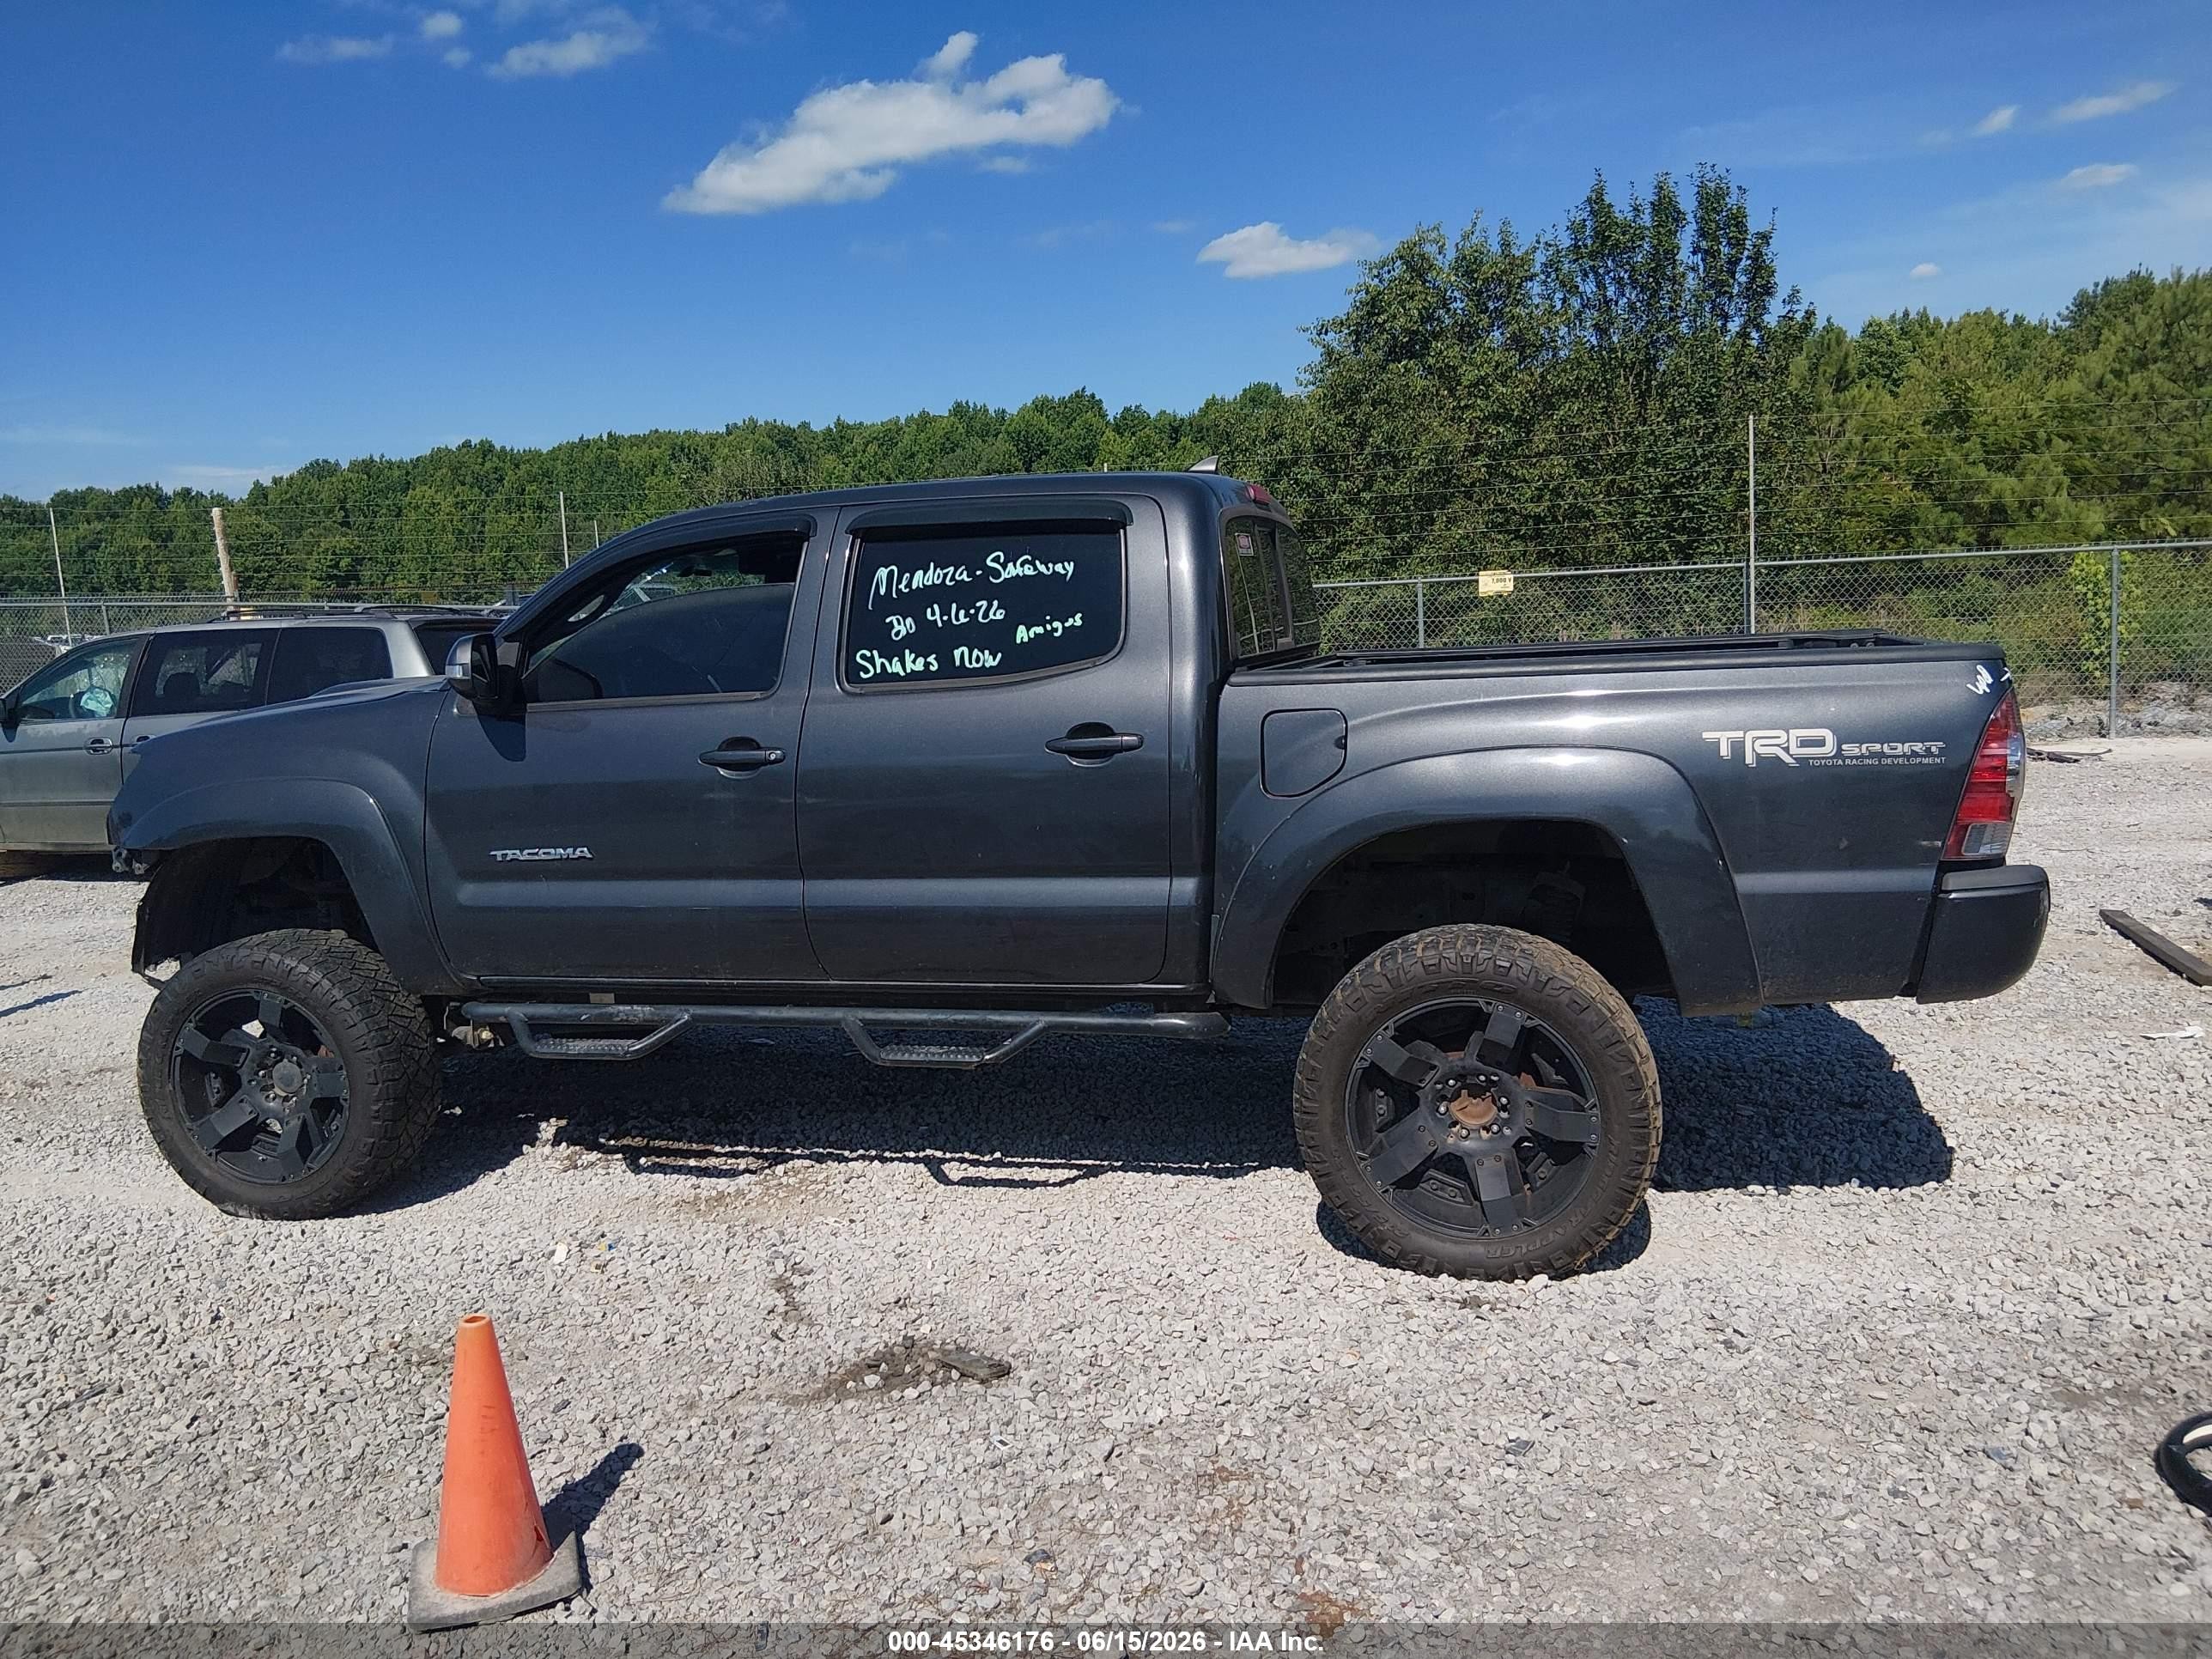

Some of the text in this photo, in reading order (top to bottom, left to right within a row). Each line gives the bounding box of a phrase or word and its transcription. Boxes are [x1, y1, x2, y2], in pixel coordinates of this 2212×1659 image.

[868, 562, 973, 611] Mendoza
[855, 649, 939, 679] Shakes
[1702, 728, 1947, 768] TRD SPORT
[1881, 757, 1946, 765] DEVELOPMENT
[489, 847, 592, 861] TACOMA
